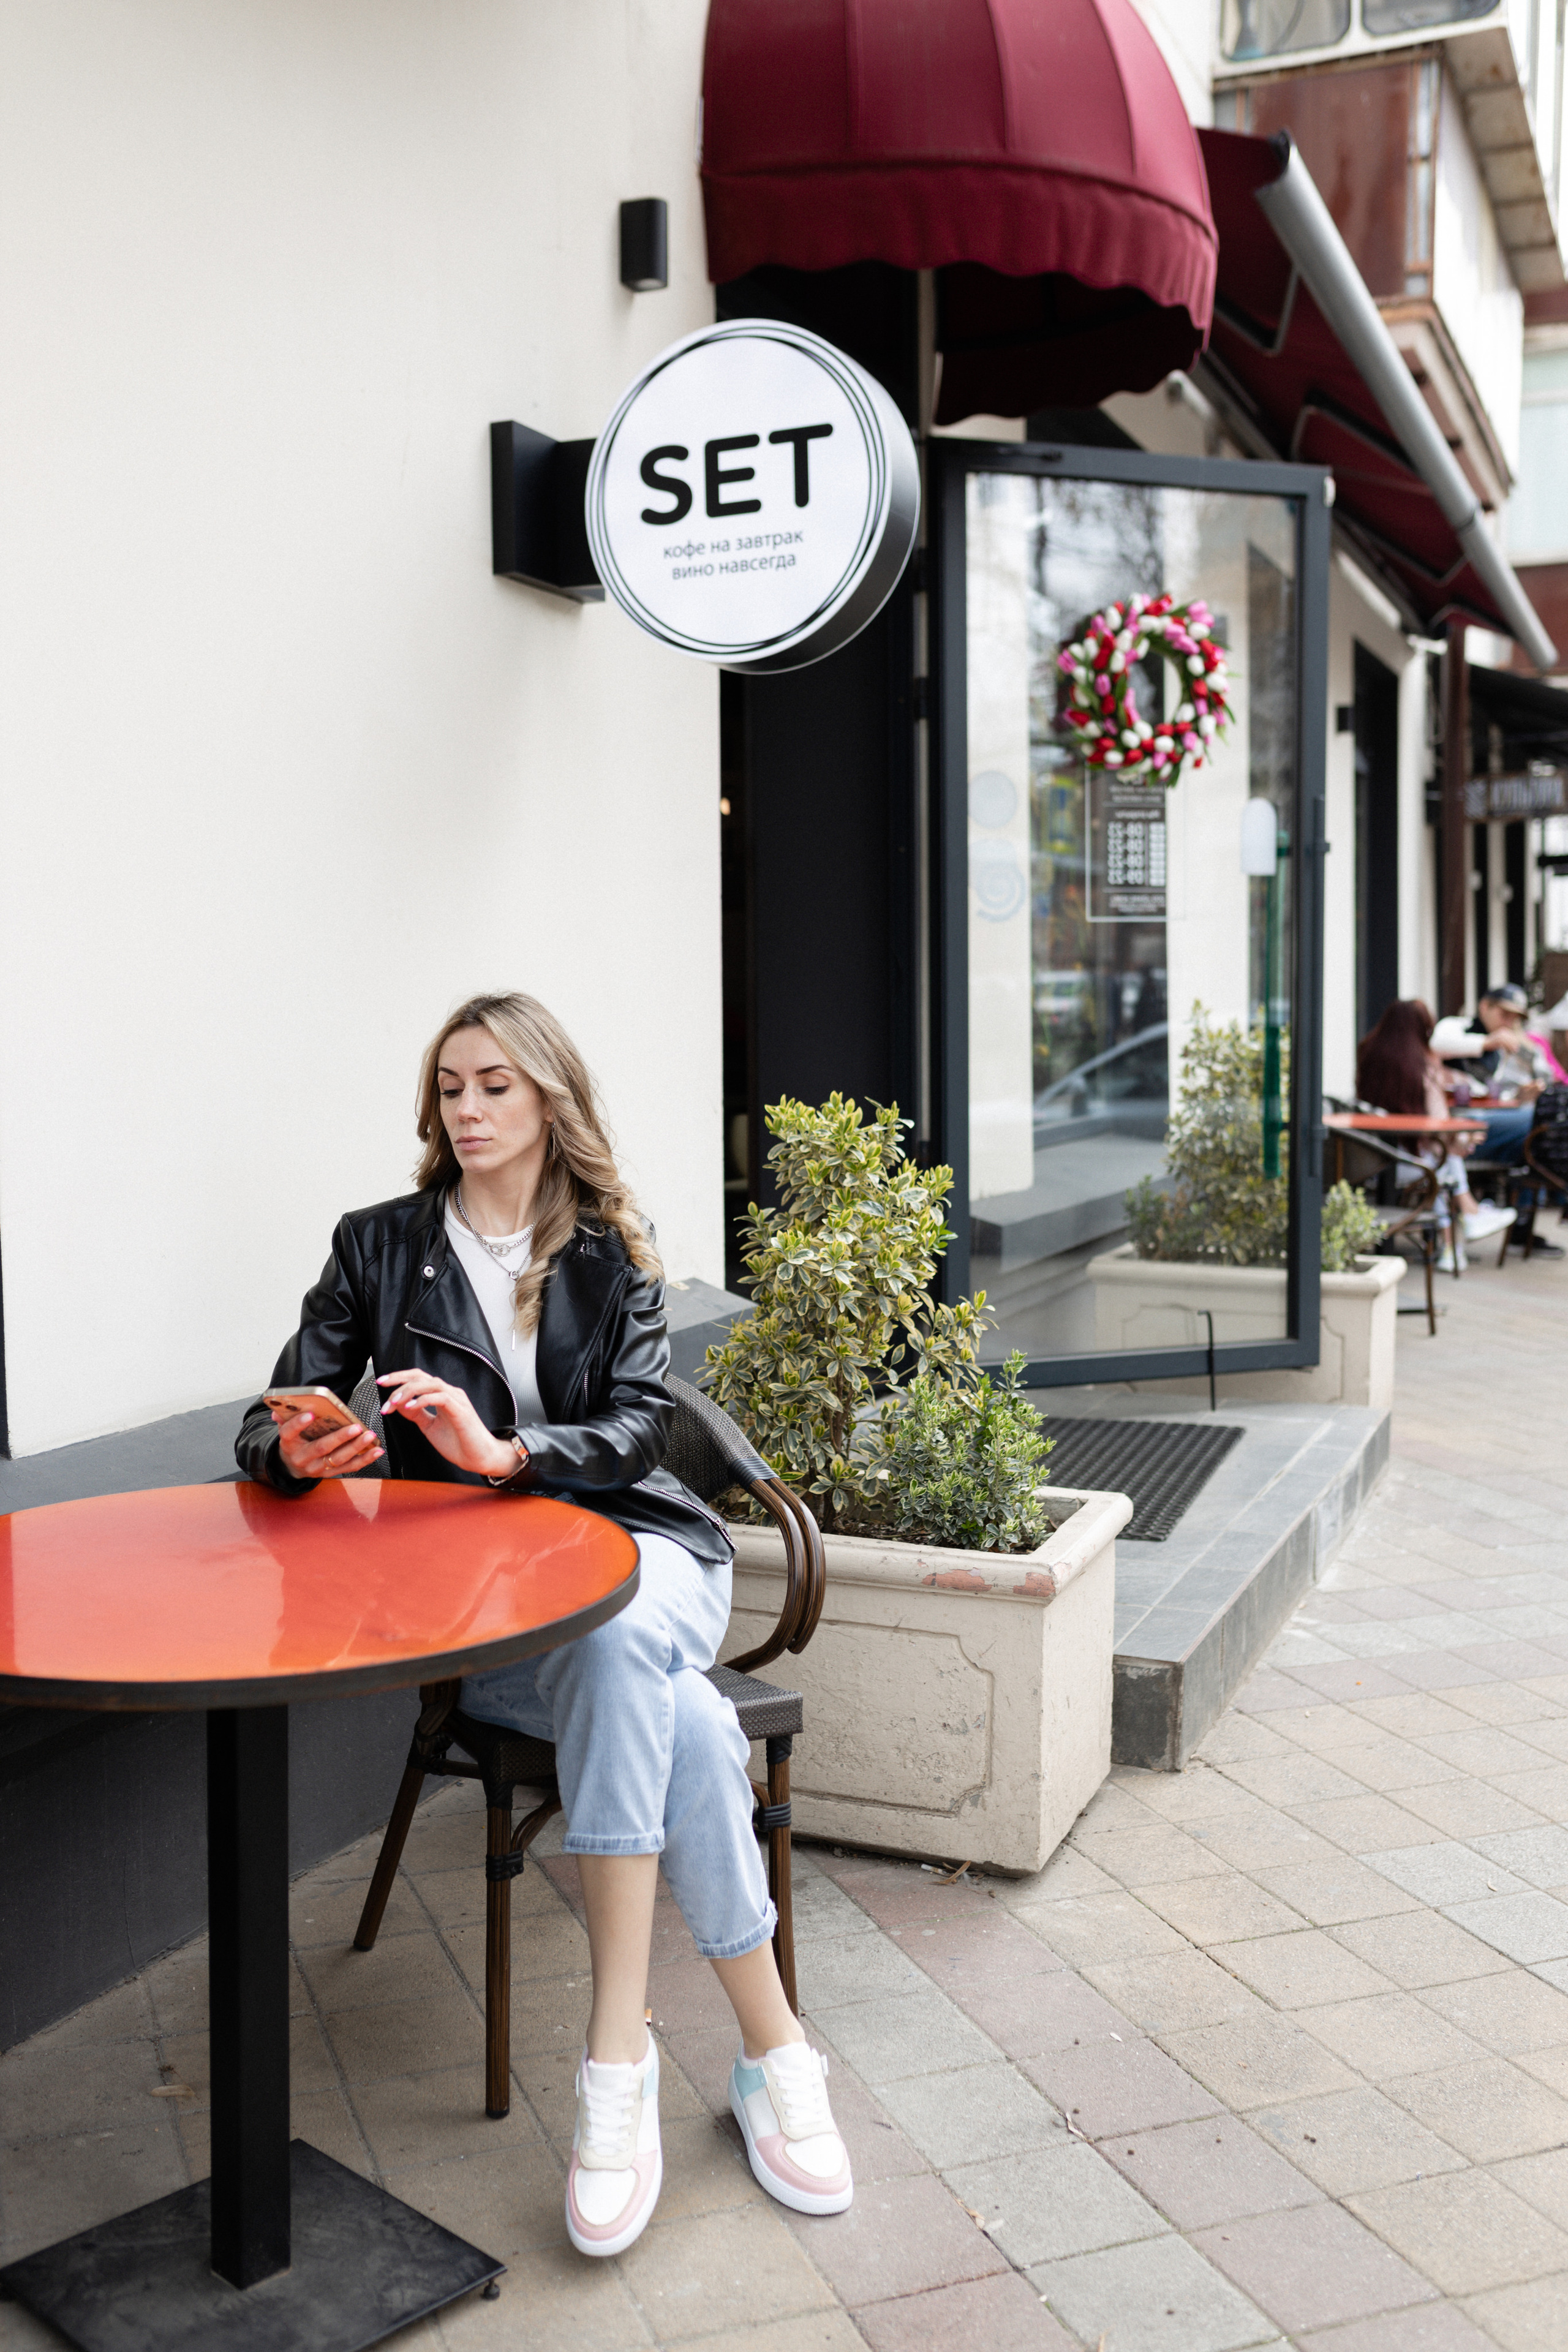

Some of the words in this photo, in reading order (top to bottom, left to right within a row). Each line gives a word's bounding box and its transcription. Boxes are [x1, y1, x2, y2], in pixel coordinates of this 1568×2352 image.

[640, 423, 834, 526] SET
[663, 538, 706, 560] кофе
[710, 540, 731, 553] на
[736, 531, 804, 551] завтрак
[673, 564, 715, 580] вино
[719, 554, 796, 575] навсегда
